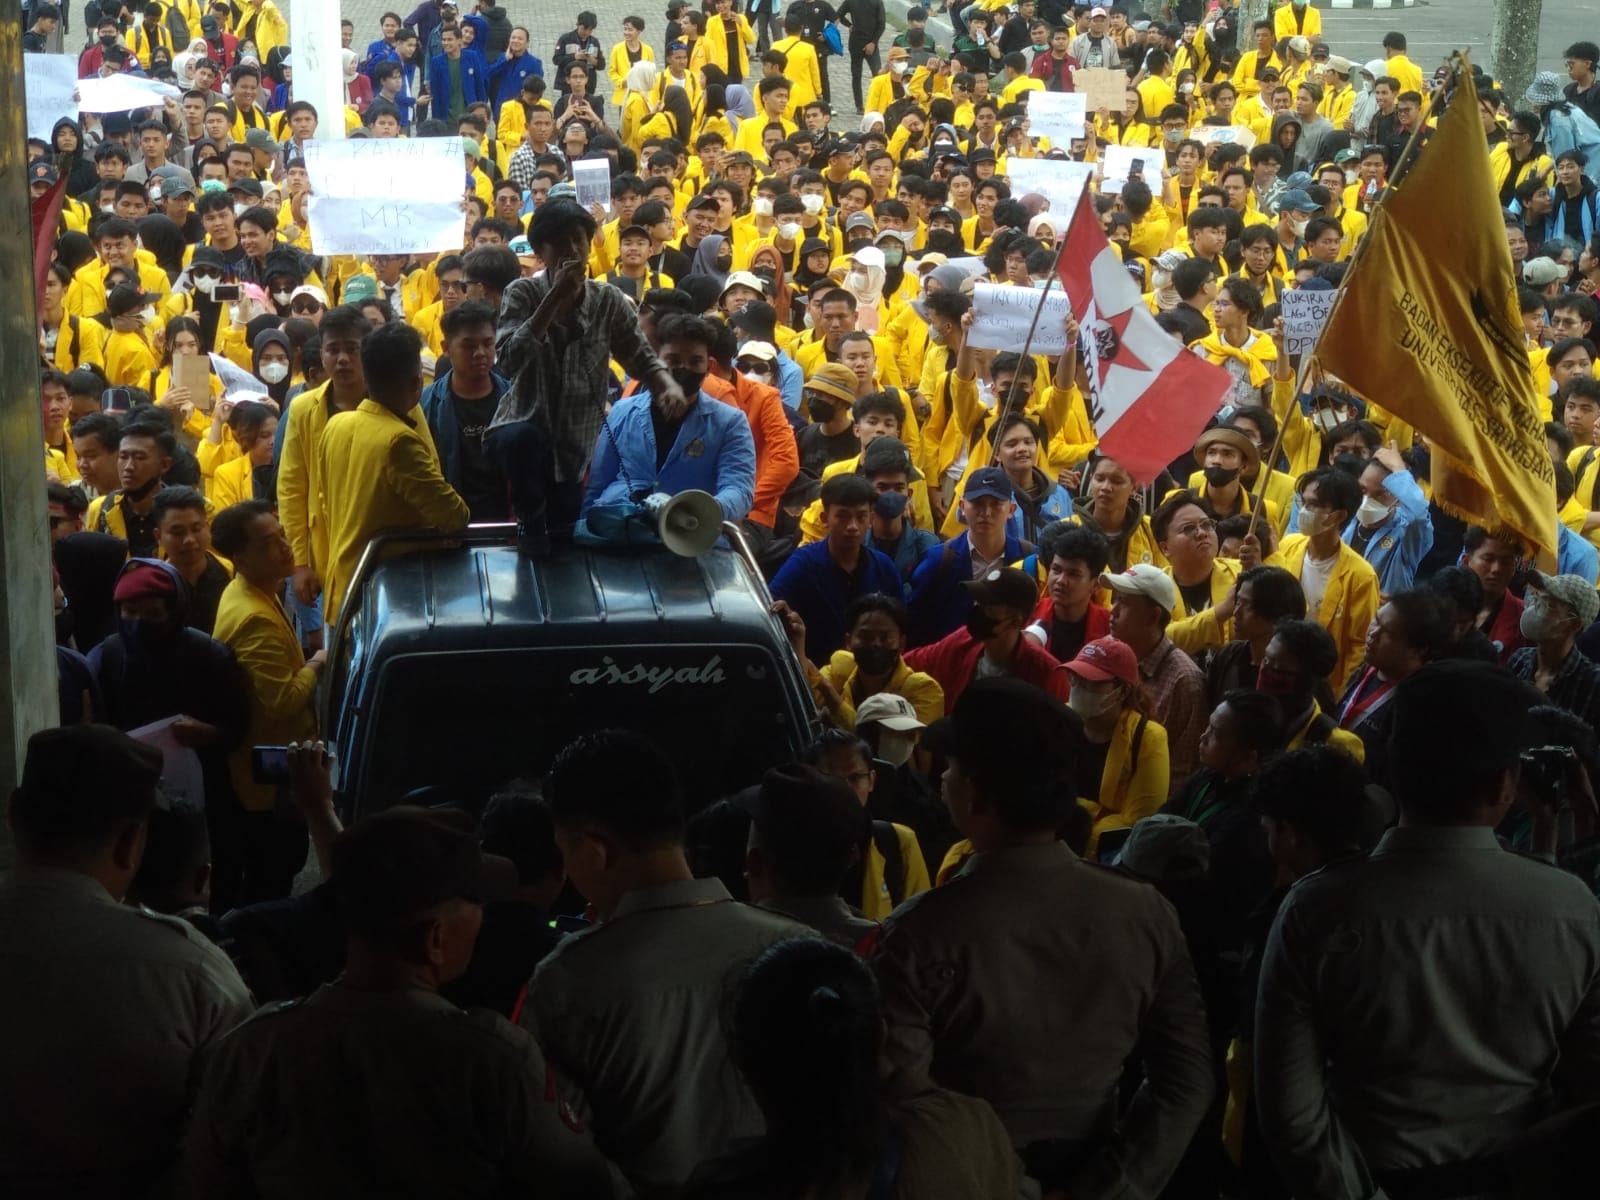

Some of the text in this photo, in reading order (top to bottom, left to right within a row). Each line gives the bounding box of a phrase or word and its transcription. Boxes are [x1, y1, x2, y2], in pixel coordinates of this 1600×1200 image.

[361, 205, 412, 229] MK
[1283, 291, 1324, 305] KUKIRA
[1400, 291, 1439, 343] BADAN
[1436, 335, 1513, 406] EKSEKUTIF
[1401, 328, 1486, 422] UNIVERSITAS
